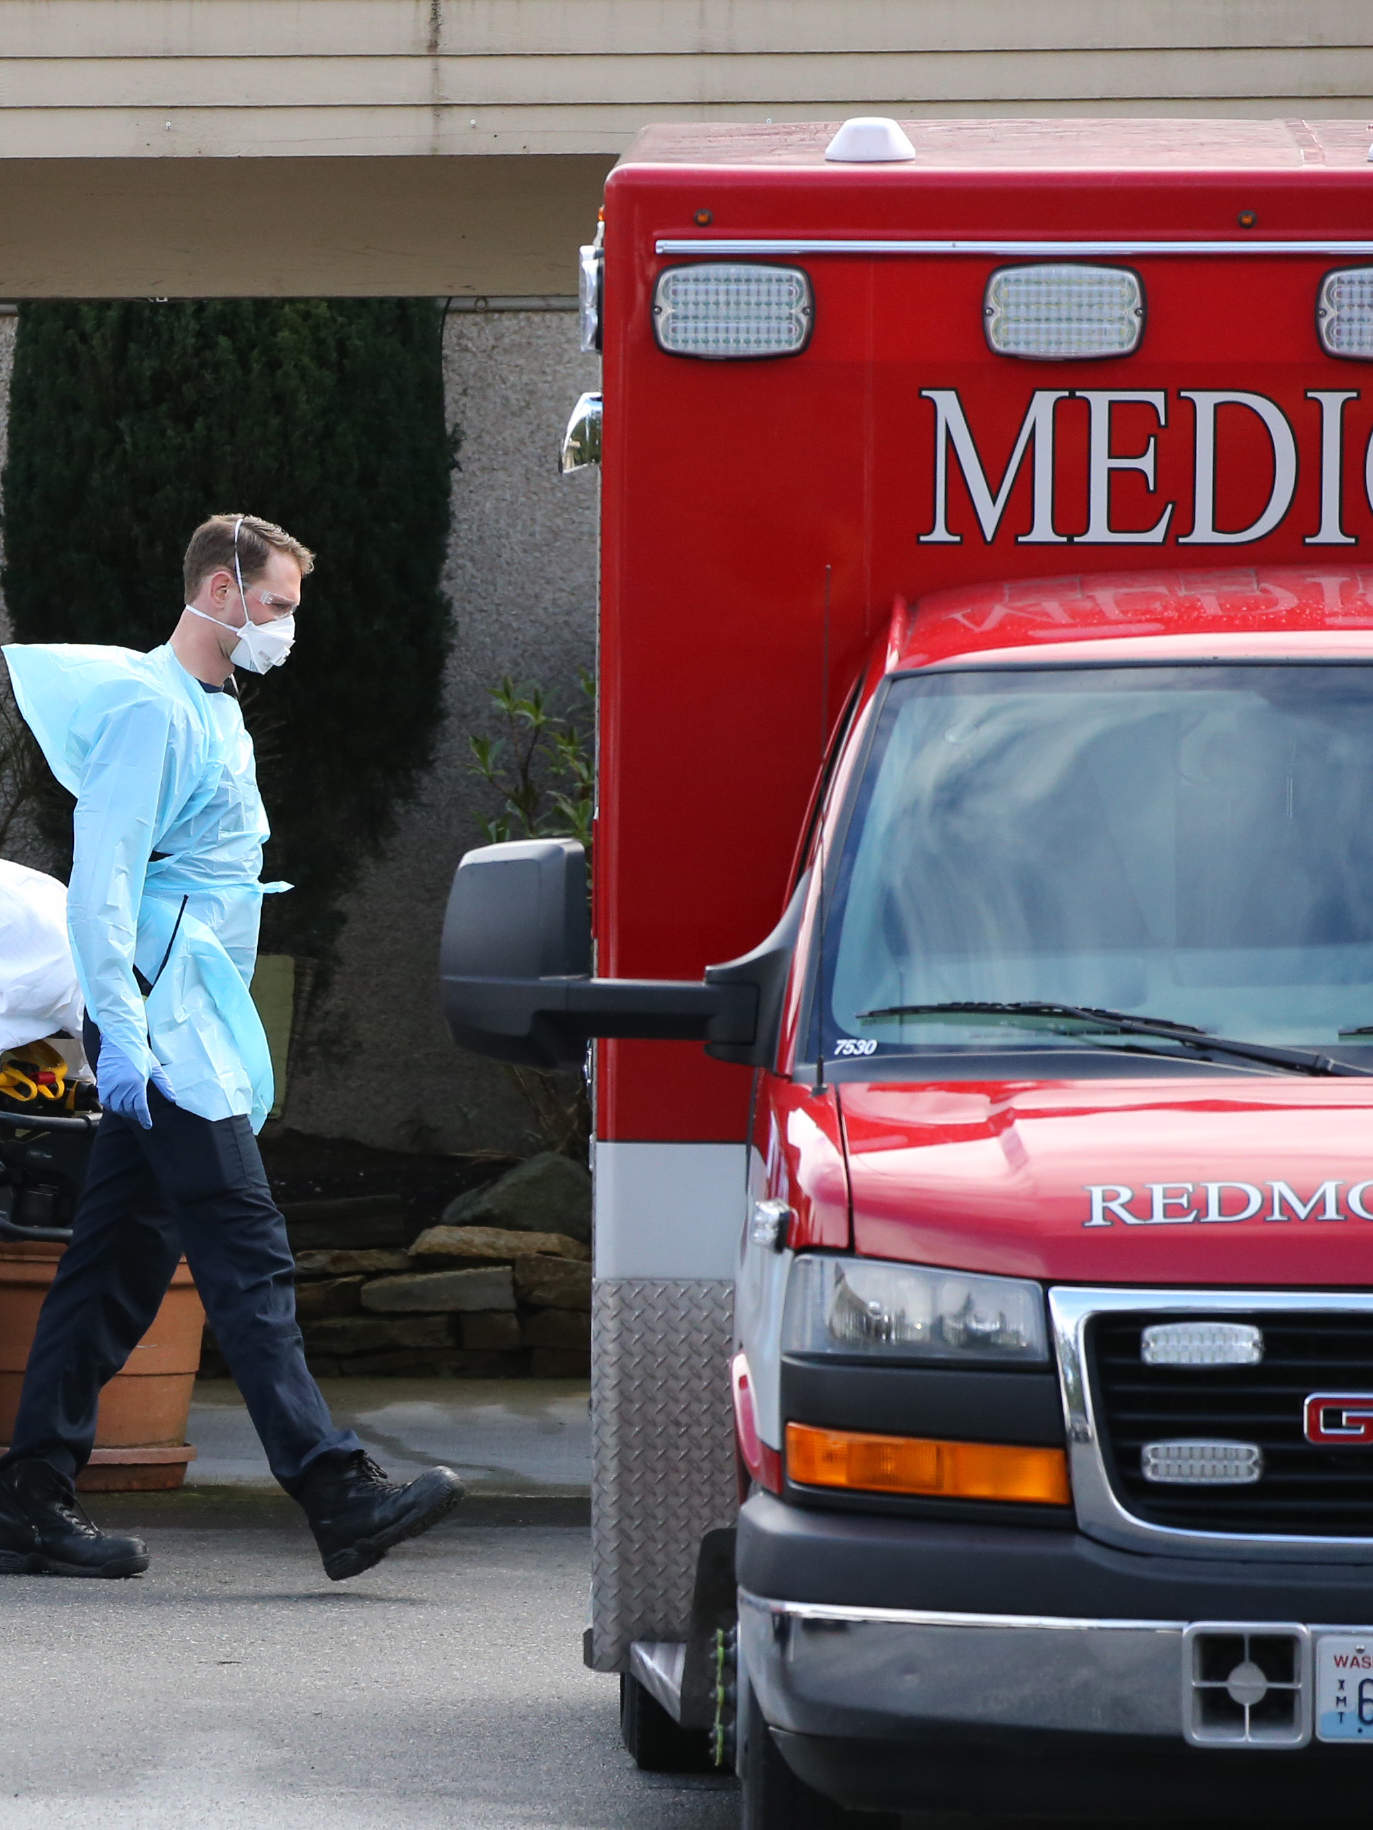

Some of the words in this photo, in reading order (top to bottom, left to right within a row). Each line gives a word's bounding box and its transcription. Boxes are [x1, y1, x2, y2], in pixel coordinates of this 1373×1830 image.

[916, 388, 1373, 545] MEDI
[833, 1038, 878, 1056] 7530
[1334, 1655, 1373, 1669] WAS
